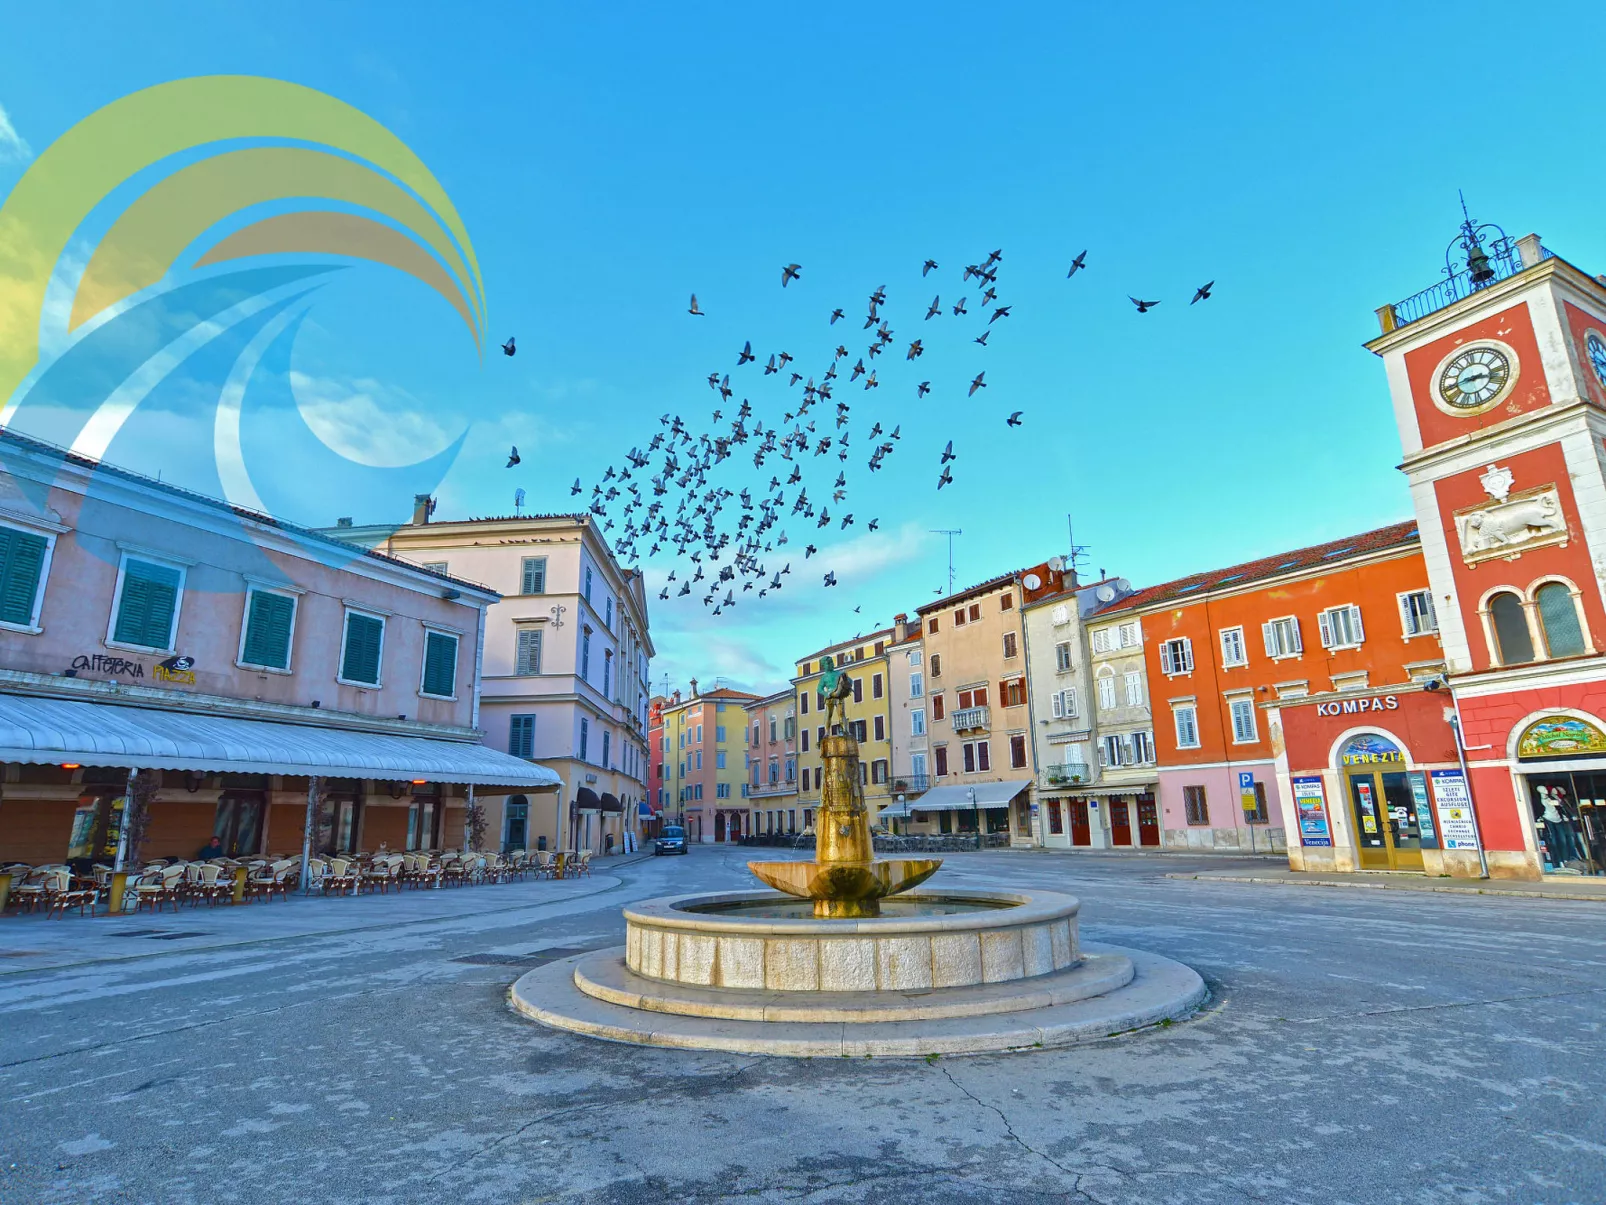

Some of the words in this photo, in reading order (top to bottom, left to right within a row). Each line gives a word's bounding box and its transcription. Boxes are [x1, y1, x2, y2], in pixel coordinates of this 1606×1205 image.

[72, 654, 144, 678] CAFFETERIA
[153, 664, 196, 685] PIAZZA
[1317, 695, 1399, 717] KOMPAS
[1343, 752, 1406, 765] VENEZIA
[1242, 774, 1250, 786] P
